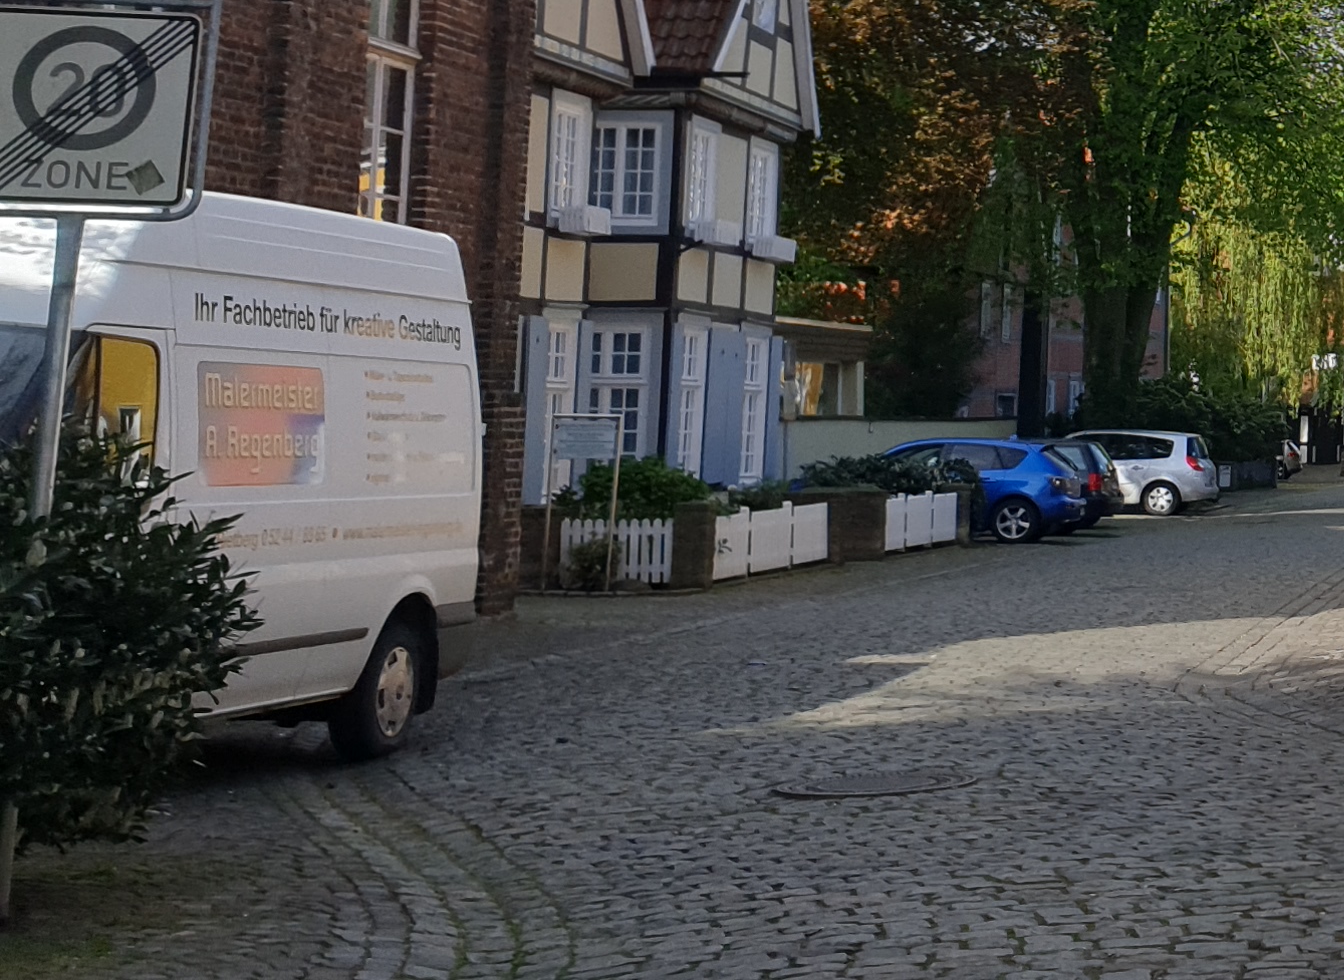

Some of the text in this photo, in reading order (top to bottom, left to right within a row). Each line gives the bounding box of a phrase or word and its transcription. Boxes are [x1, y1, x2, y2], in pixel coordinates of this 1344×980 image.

[48, 61, 126, 119] 20
[21, 158, 131, 192] ZONE
[195, 292, 461, 351] Ihr Fachbetrieb für kreative Gestaltung
[205, 372, 322, 410] Malermeister
[205, 425, 323, 474] A. Regenberg
